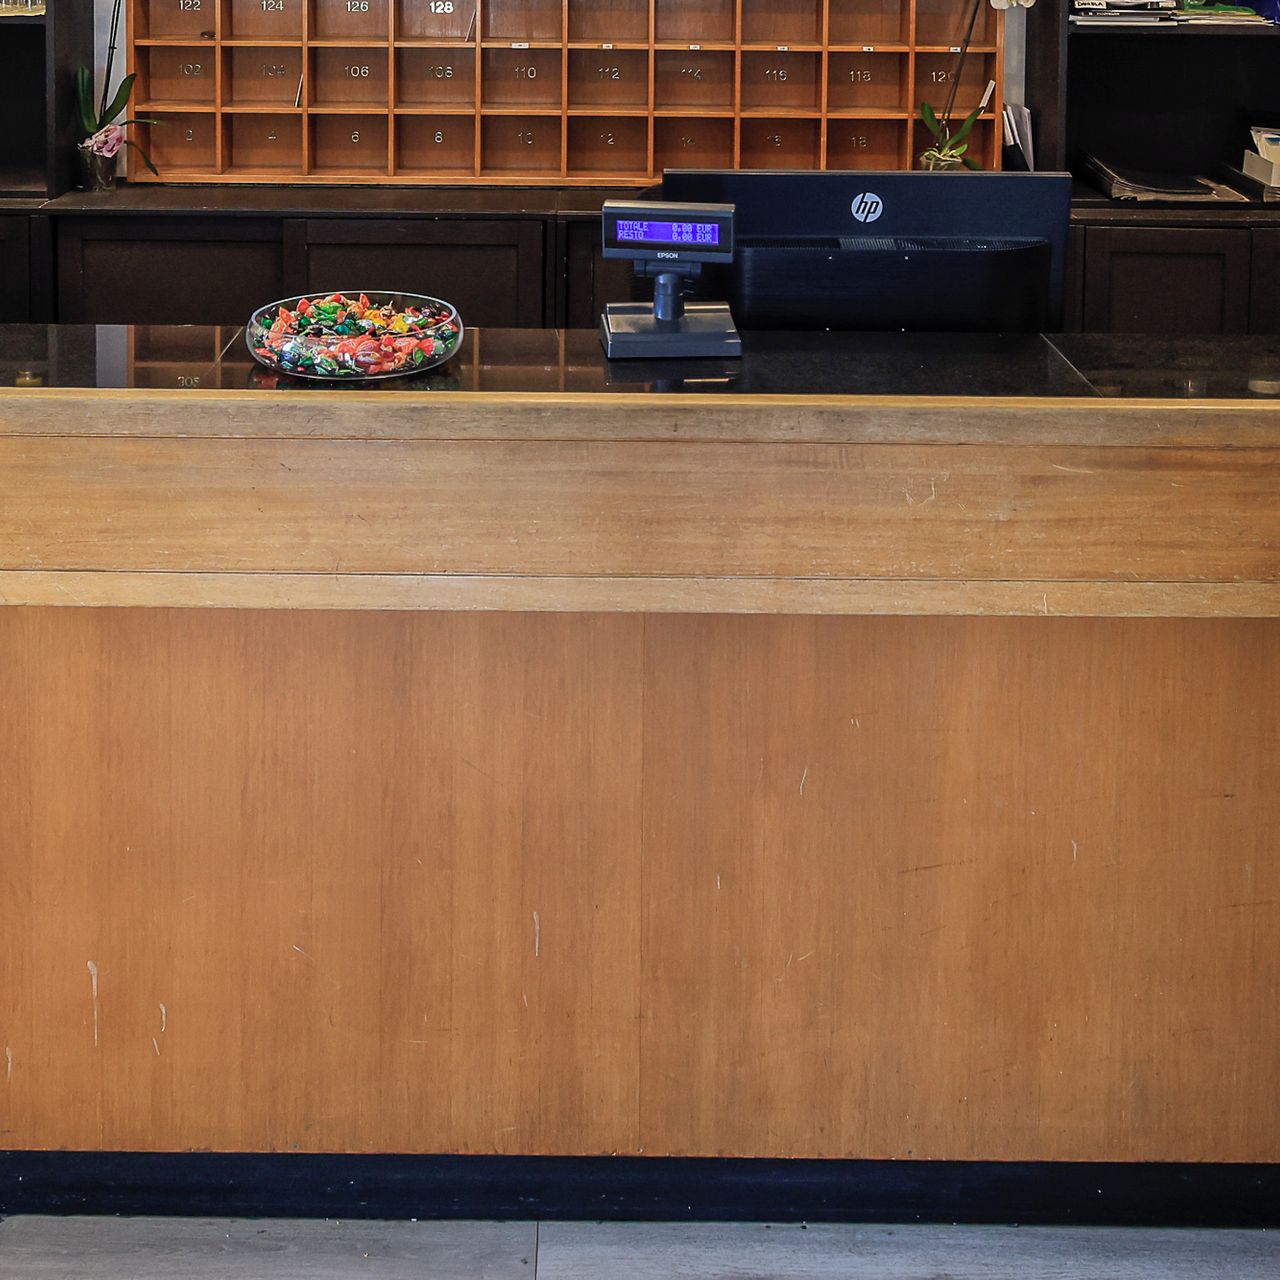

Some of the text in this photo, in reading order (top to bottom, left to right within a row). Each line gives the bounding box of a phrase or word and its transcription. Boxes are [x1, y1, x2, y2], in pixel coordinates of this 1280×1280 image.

[178, 0, 201, 11] 122
[261, 0, 284, 12] 124
[345, 0, 369, 13] 126
[429, 1, 454, 14] 128
[178, 64, 202, 76] 102
[344, 65, 369, 77] 106
[515, 66, 537, 79] 110
[351, 131, 360, 142] 6
[434, 131, 443, 143] 8
[853, 193, 882, 222] hp
[618, 221, 648, 231] TOTALE
[696, 224, 712, 233] EUR
[618, 230, 644, 240] RESTO
[696, 234, 712, 242] EUR
